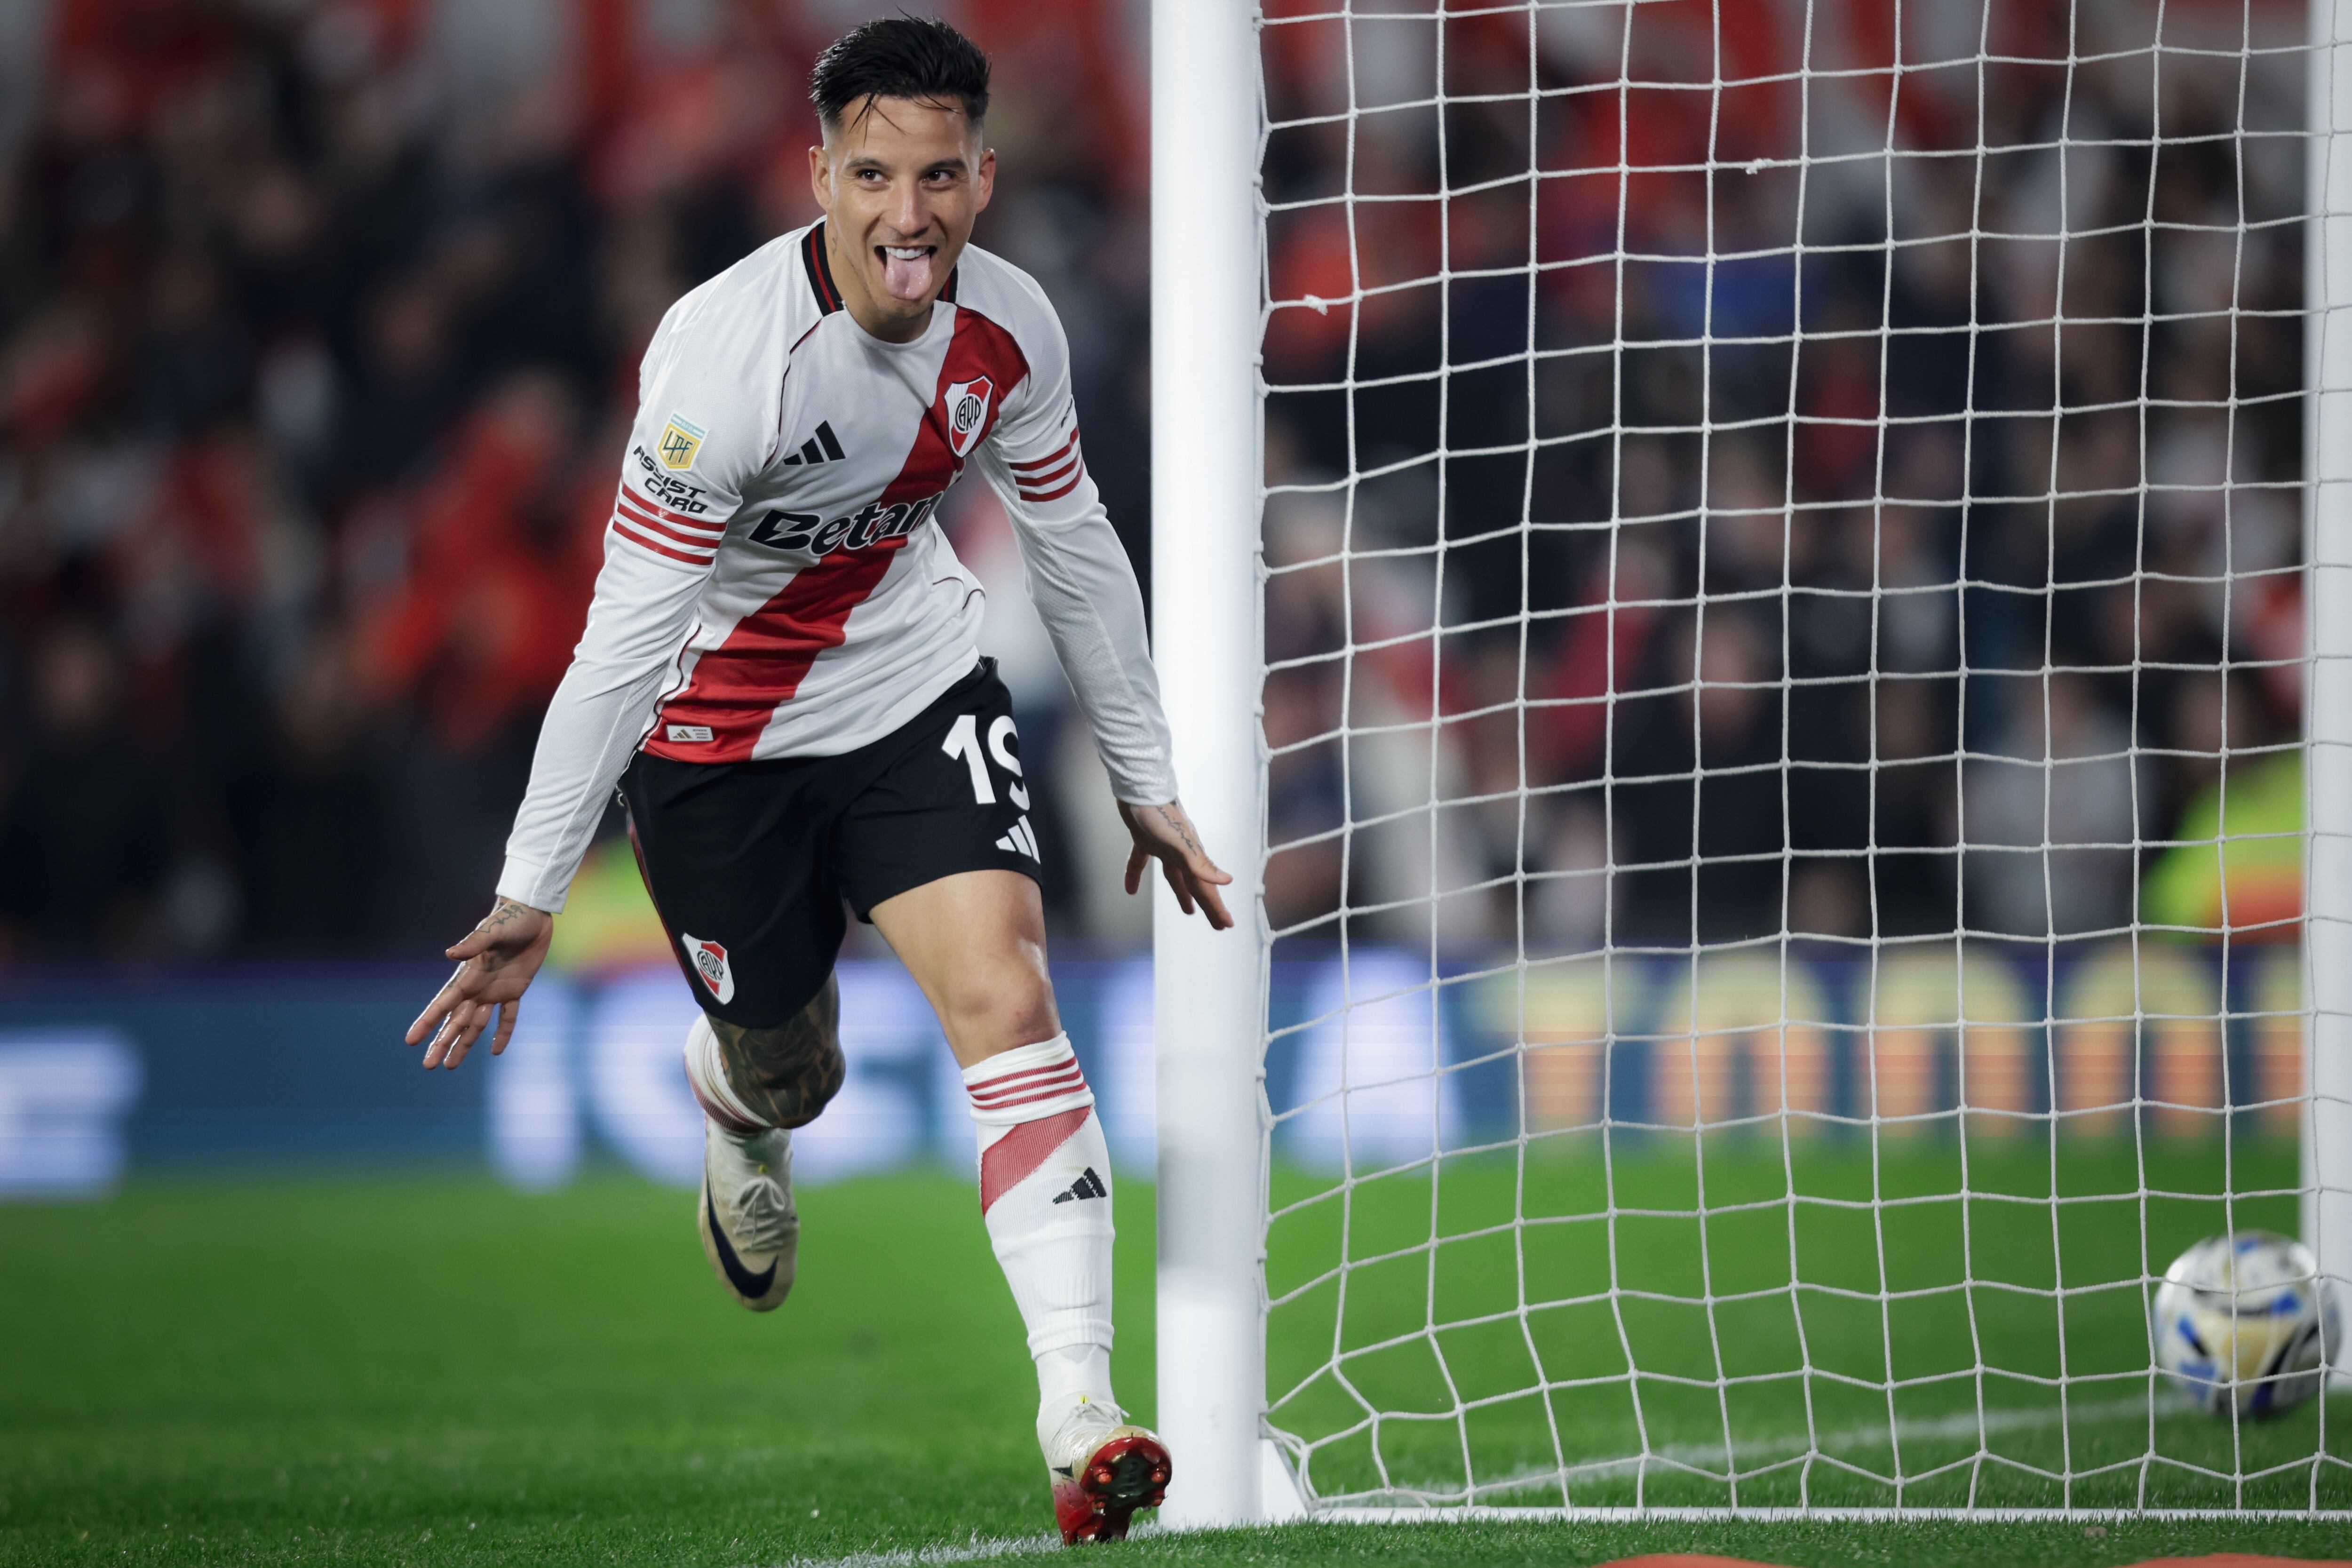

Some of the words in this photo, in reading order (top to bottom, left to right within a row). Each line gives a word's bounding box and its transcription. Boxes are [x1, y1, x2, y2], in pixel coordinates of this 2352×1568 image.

[955, 395, 981, 431] CARP
[633, 445, 707, 499] ASSIST
[747, 491, 944, 556] Betan
[942, 715, 1030, 811] 19
